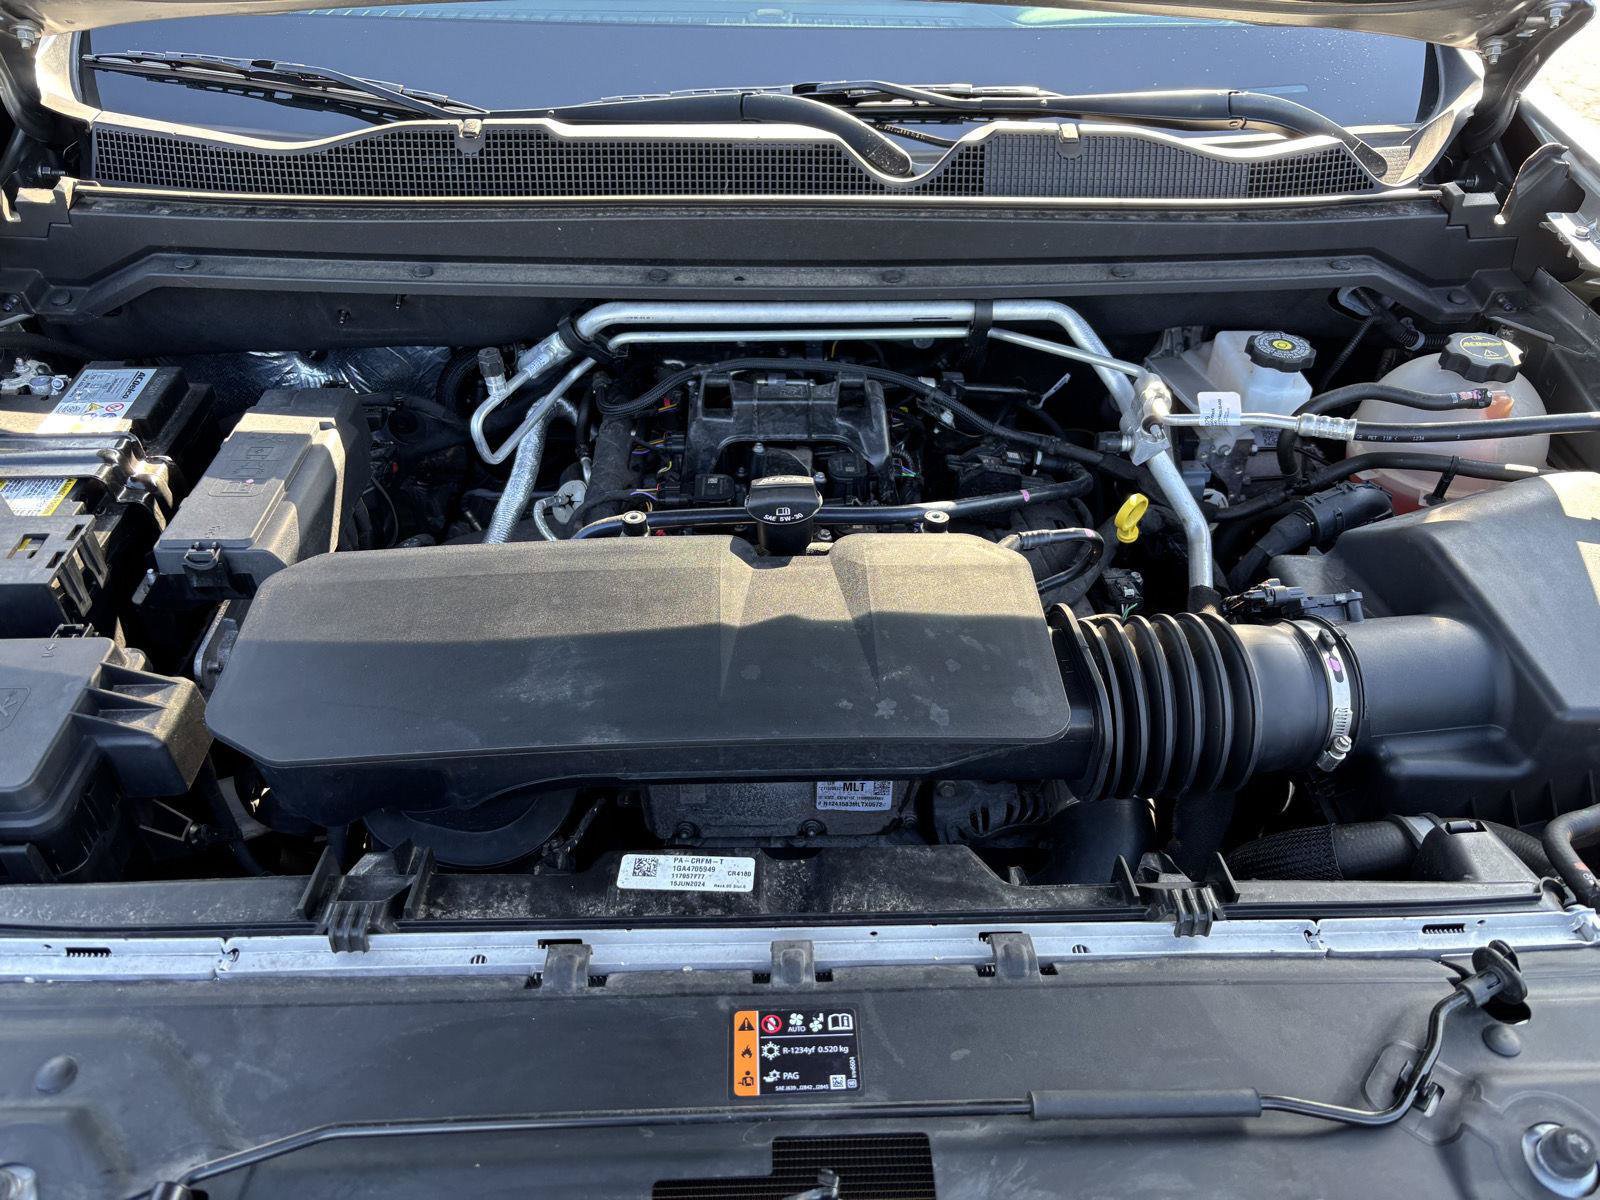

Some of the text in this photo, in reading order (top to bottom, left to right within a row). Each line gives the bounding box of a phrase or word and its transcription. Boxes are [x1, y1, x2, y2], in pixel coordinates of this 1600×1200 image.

[779, 512, 804, 522] 5W-30
[842, 782, 866, 792] MLT
[782, 1045, 849, 1055] R-1234yf 0.520 kg
[782, 1072, 800, 1080] PAG
